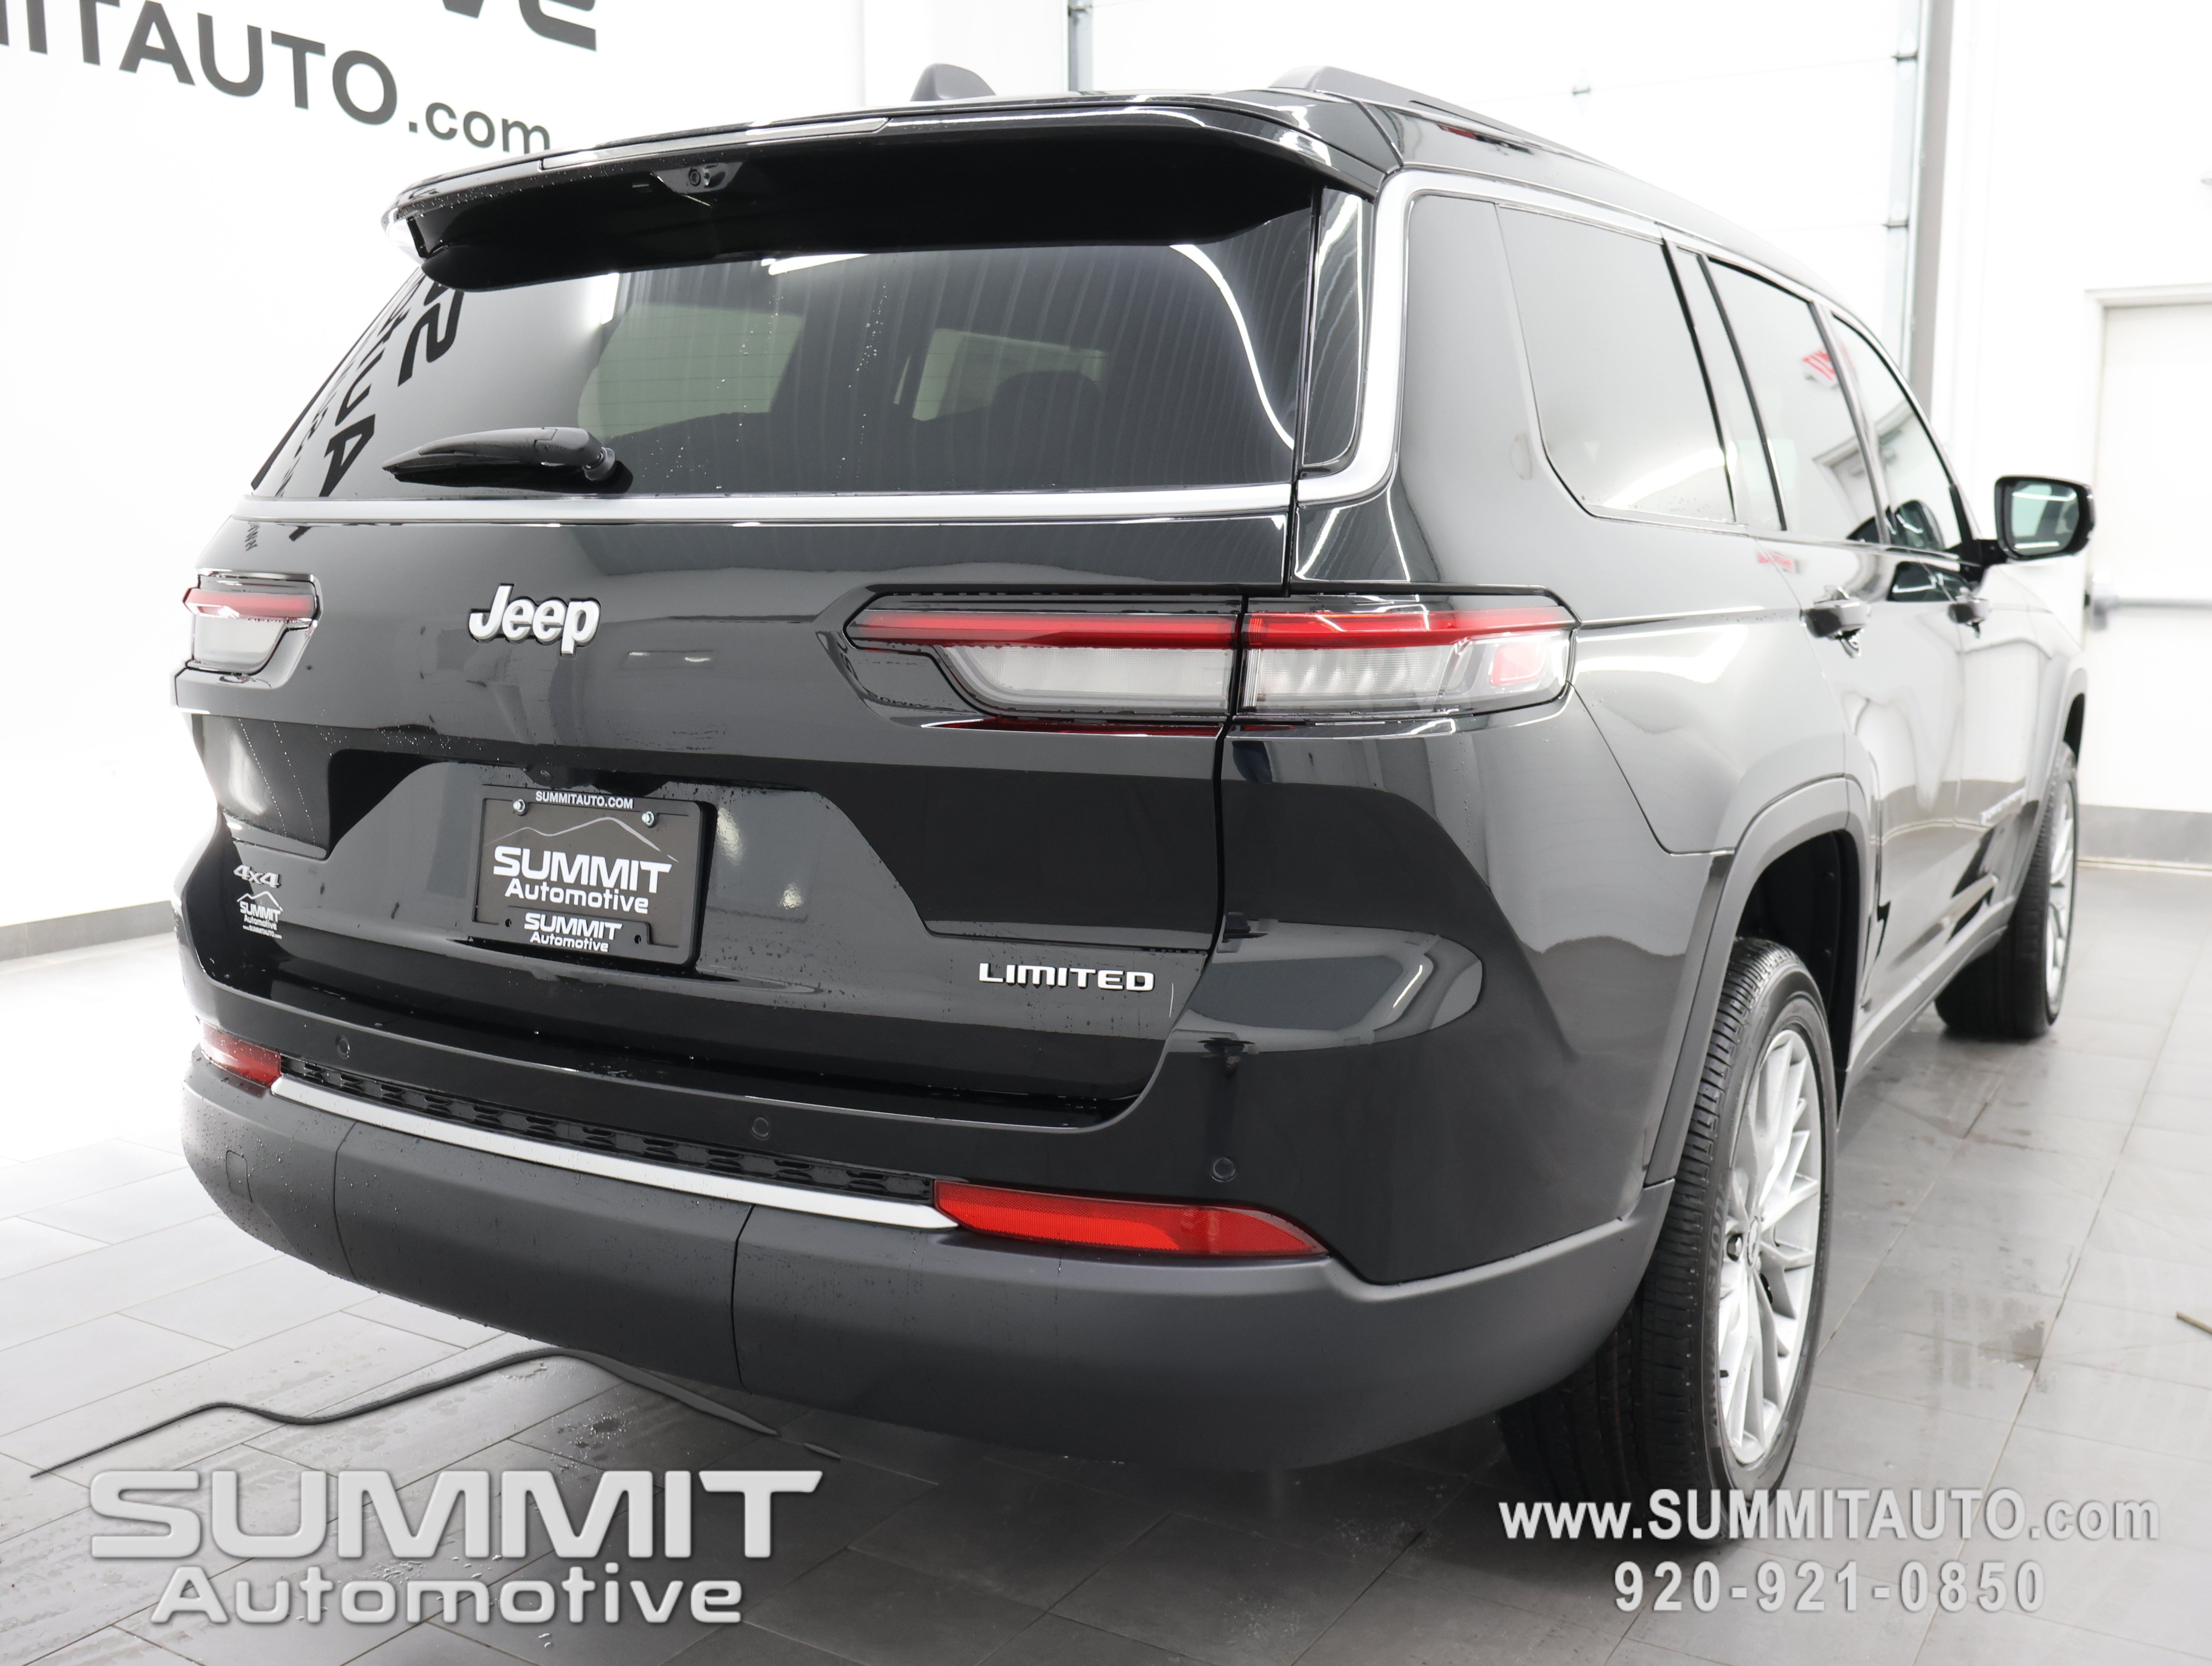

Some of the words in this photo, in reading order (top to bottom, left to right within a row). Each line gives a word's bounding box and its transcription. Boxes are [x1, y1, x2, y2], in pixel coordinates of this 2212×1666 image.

[0, 0, 550, 154] ITAUTO.com
[469, 585, 601, 654] Jeep
[535, 791, 634, 809] SUMMITAUTO.COM
[233, 865, 280, 888] 4x4
[493, 846, 672, 894] SUMMIT
[504, 878, 649, 914] Automotive
[240, 901, 281, 922] SUMMIT
[244, 914, 277, 930] Automotive
[524, 912, 623, 940] SUMMIT
[530, 931, 609, 952] Automotive
[979, 963, 1155, 992] LIMITED
